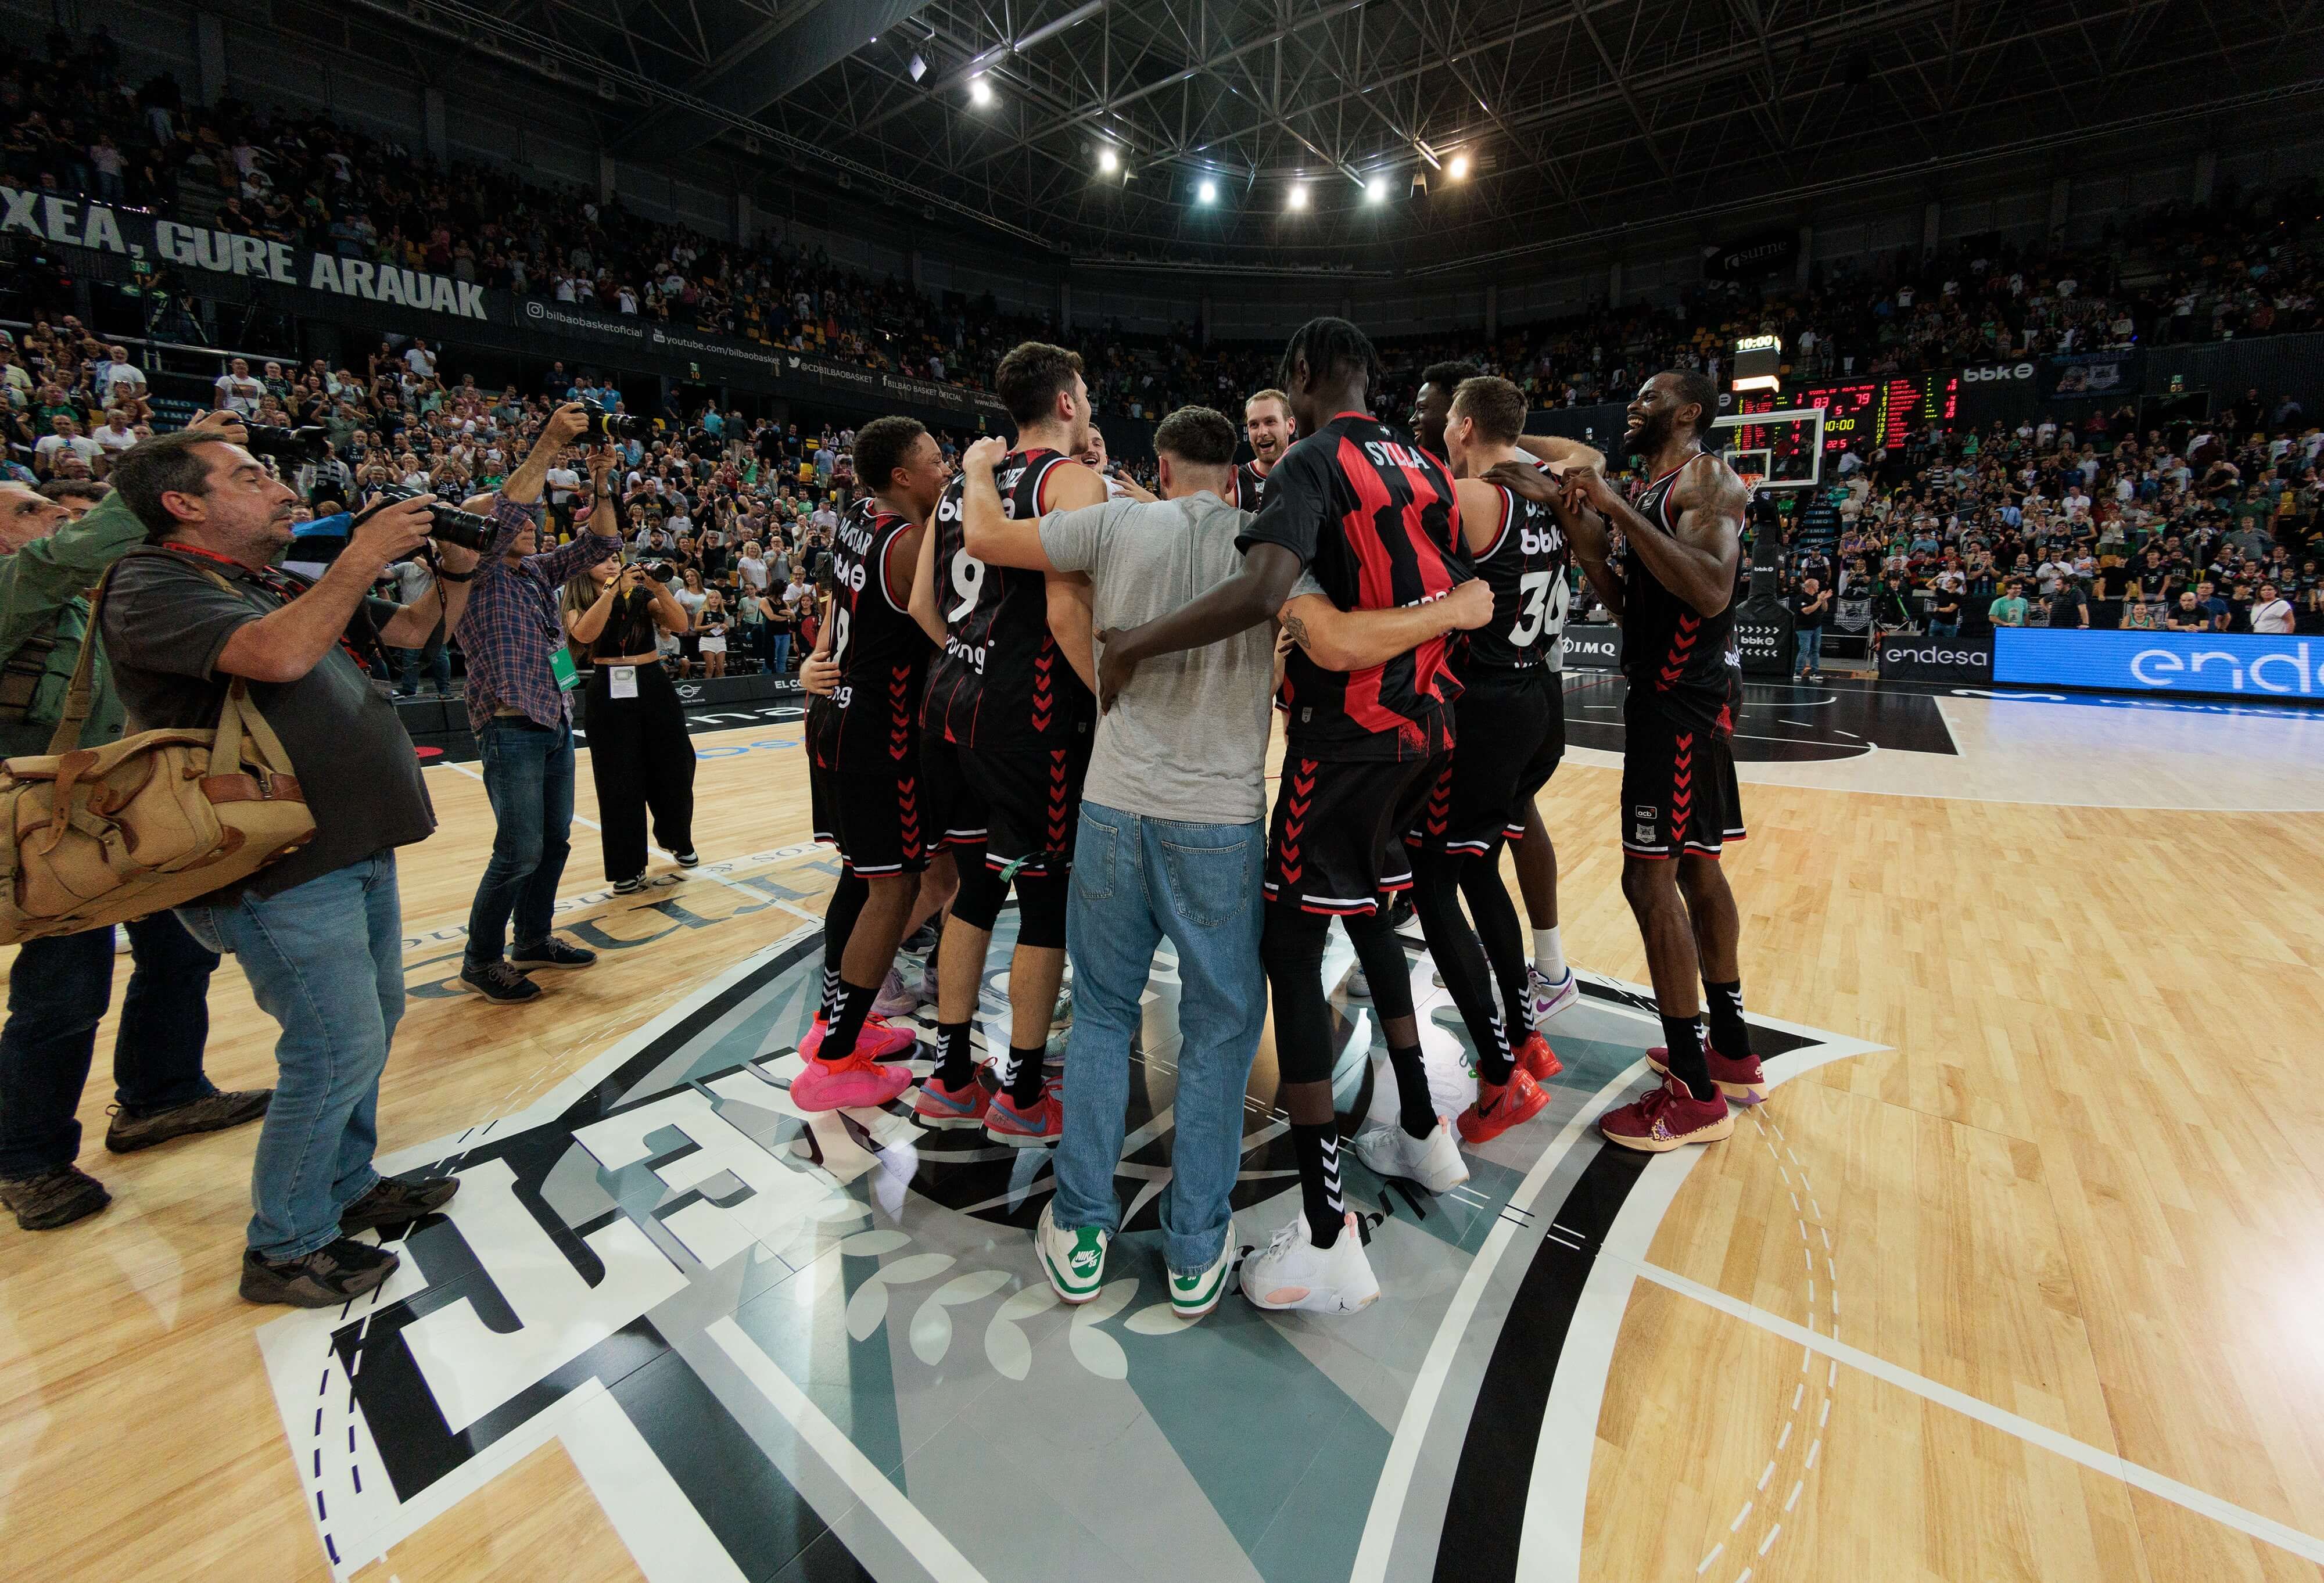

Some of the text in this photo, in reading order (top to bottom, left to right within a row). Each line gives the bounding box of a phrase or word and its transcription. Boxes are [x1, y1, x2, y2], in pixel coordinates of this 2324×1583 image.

[1740, 242, 1788, 261] surne
[156, 220, 297, 285] GURE
[310, 252, 487, 321] ARAUAK
[546, 309, 643, 338] bilbaobasketoficial
[1737, 335, 1774, 350] 10:00
[666, 337, 781, 365] youtube.com/bilbaobasket
[801, 362, 873, 384] @CDBILBAOBASKET
[1964, 366, 2011, 382] bbk
[888, 380, 912, 392] BILBAO
[913, 385, 937, 397] BASKET
[938, 390, 963, 402] OFICIAL
[1813, 393, 1871, 409] 83 79
[1834, 405, 1844, 415] 5
[1824, 419, 1855, 432] 10:00
[1364, 441, 1431, 469] SYLLA
[948, 547, 985, 623] 9
[1740, 636, 1764, 645] bbk
[1575, 641, 1616, 657] IMQ
[1886, 646, 1988, 666] endesa
[774, 680, 790, 689] EL
[1075, 1250, 1096, 1261] NIKE
[1088, 1259, 1098, 1268] SB
